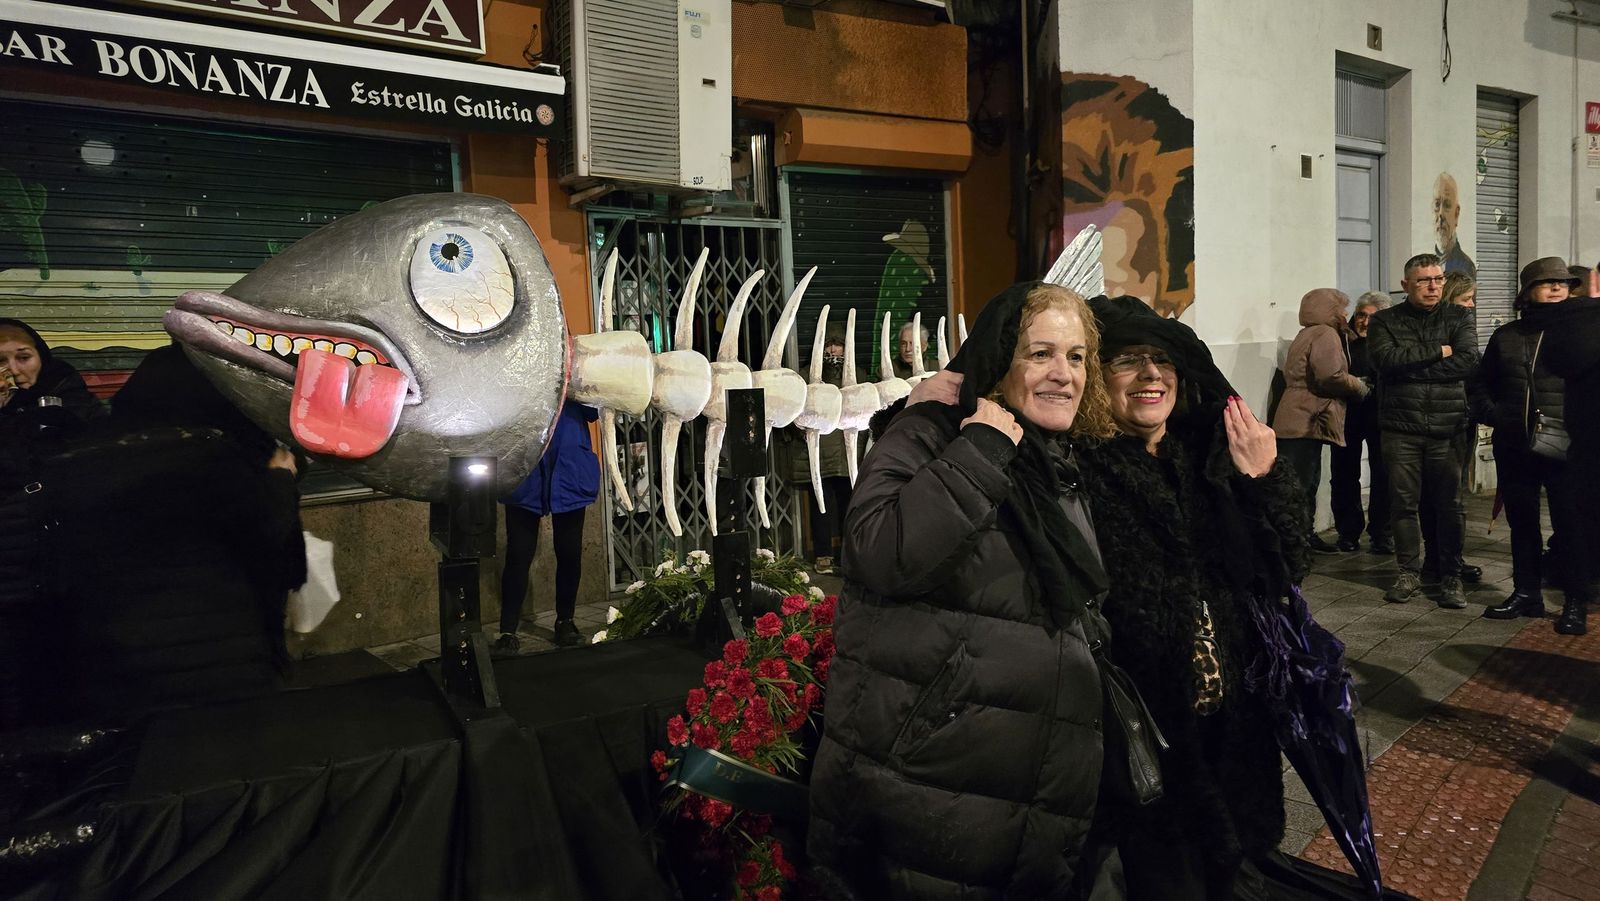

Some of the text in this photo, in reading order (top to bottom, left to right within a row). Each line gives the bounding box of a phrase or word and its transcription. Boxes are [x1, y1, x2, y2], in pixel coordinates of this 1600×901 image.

[0, 30, 331, 109] AR BONANZA
[350, 81, 534, 124] Estrella Galicia
